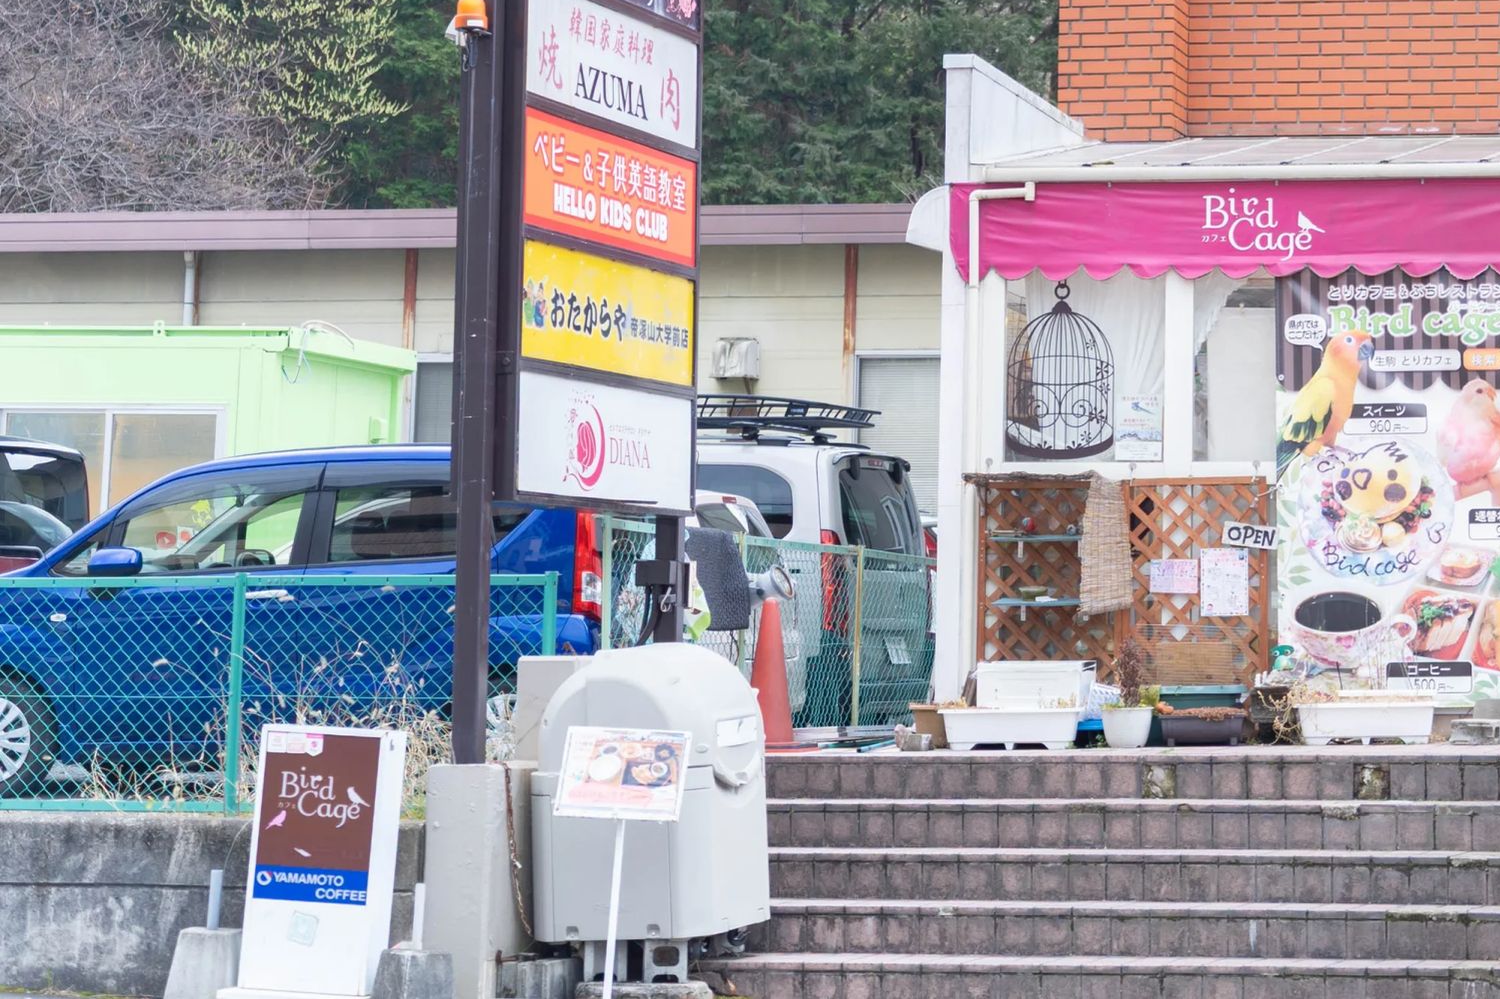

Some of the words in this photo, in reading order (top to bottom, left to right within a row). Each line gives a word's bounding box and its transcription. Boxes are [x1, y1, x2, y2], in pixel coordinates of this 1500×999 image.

[569, 7, 654, 66] 韓国家庭料理
[574, 62, 649, 121] AZUMA
[660, 67, 681, 131] 肉
[553, 183, 597, 222] HELLO
[600, 195, 632, 232] KIDS
[635, 207, 668, 242] CLUB
[1202, 187, 1278, 229] Bird
[1228, 217, 1312, 261] Cage
[551, 288, 627, 342] おたからや
[1328, 303, 1416, 337] Bird
[1363, 405, 1406, 417] スイーツ
[609, 437, 651, 469] DIANA
[1227, 526, 1277, 547] OPEN
[1322, 541, 1370, 577] Bird
[1374, 549, 1422, 576] cage
[1407, 664, 1451, 676] コーヒー
[278, 766, 336, 800] Bird
[297, 790, 361, 828] Cage
[273, 871, 344, 887] YAMAMOTO
[315, 888, 367, 902] COFFEE
